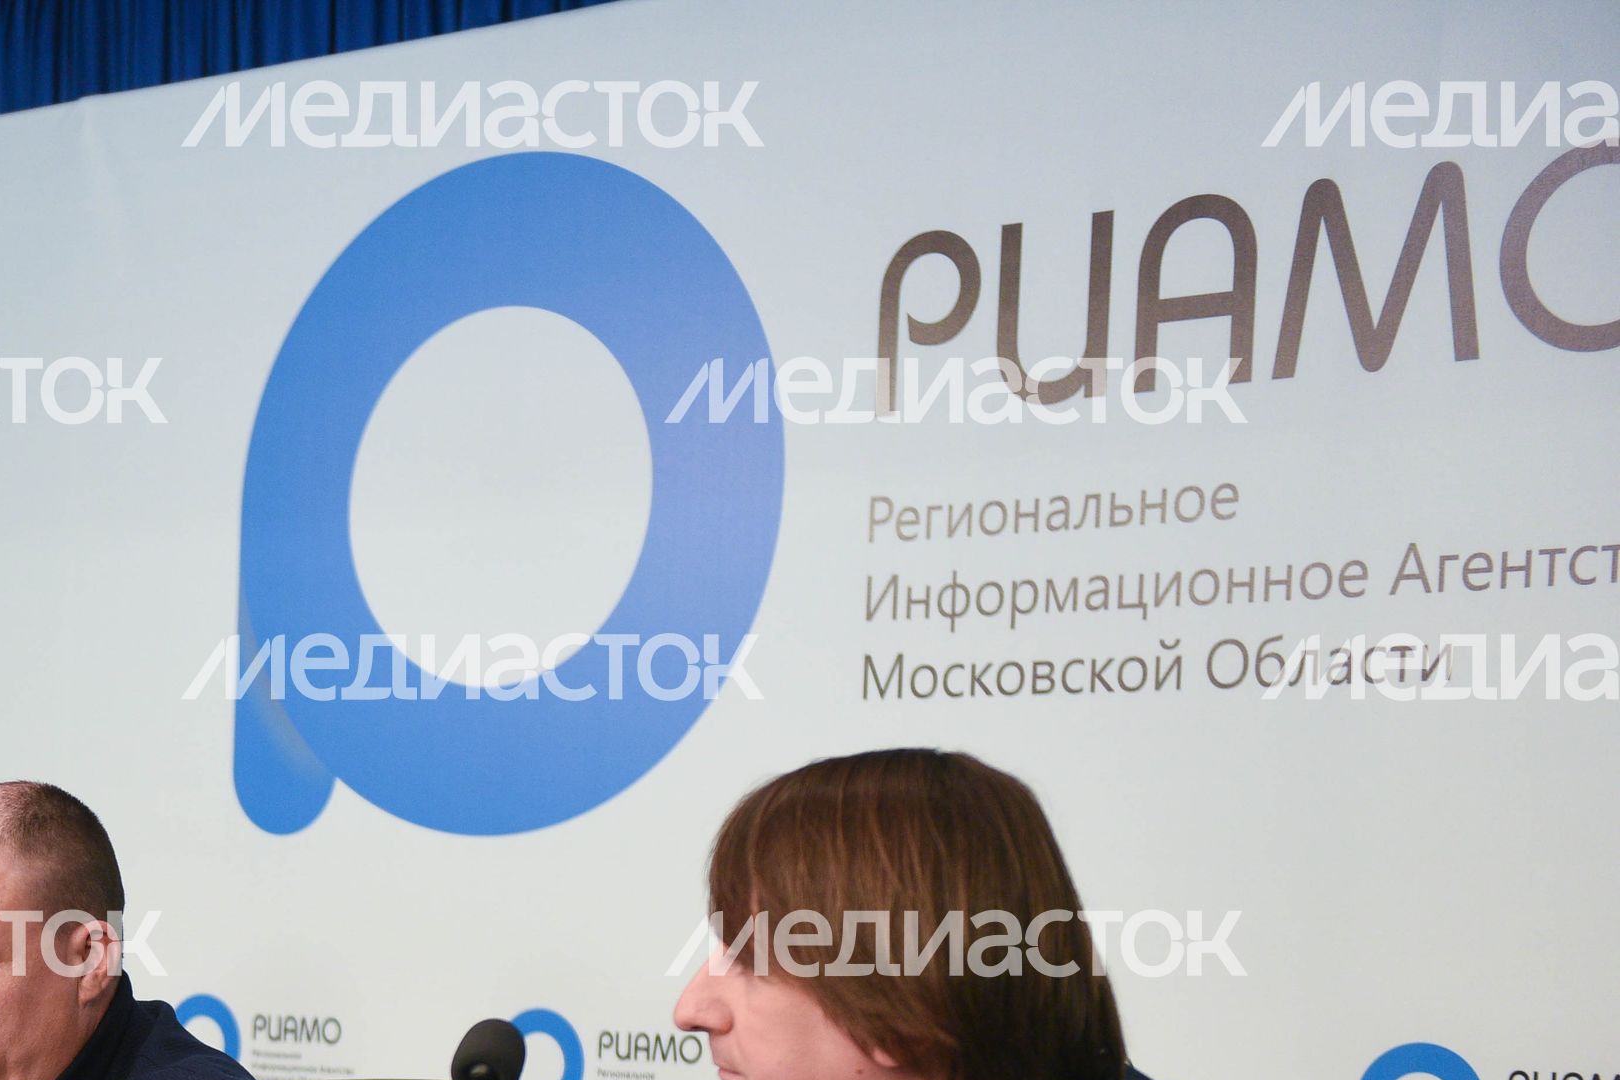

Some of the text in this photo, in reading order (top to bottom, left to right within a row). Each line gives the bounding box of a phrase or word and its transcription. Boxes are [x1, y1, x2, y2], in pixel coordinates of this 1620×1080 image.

[876, 136, 1620, 416] РИАМО
[867, 482, 1240, 543] Региональное
[865, 556, 1369, 632] Информационное
[861, 634, 1453, 700] Московской Области
[253, 1014, 342, 1044] РИАМО
[598, 1030, 702, 1064] РИАМО
